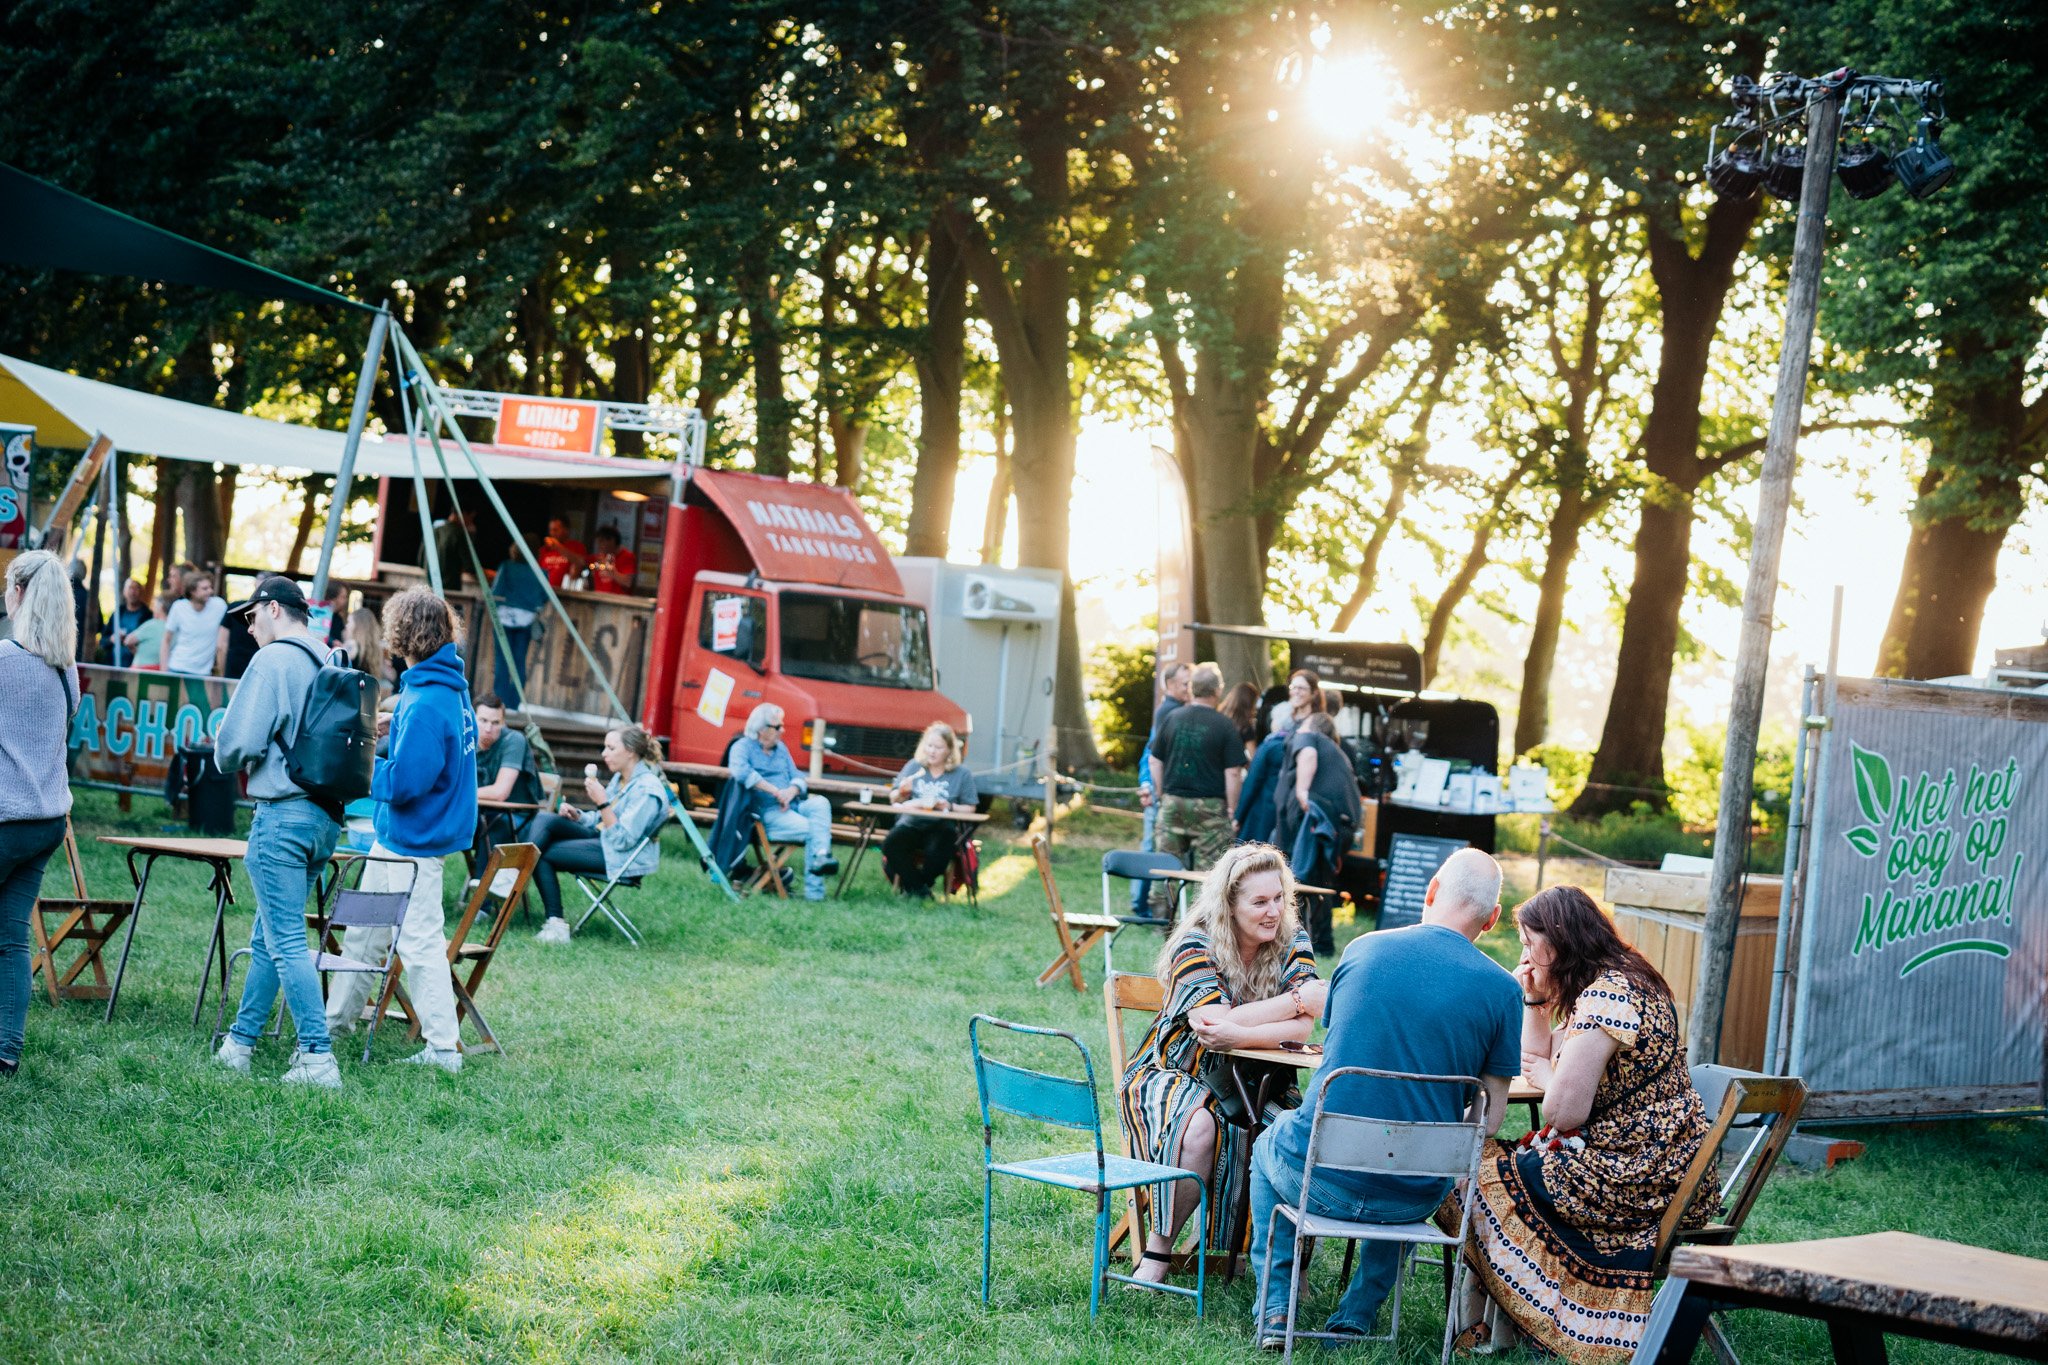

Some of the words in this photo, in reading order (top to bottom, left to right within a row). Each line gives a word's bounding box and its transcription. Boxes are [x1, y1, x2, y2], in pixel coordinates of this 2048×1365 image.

[516, 404, 580, 432] NATHALS
[746, 500, 863, 540] NATHALS
[766, 532, 877, 564] TANKWAGEN
[1889, 769, 1958, 836] Met
[1963, 757, 2021, 817] het
[1887, 827, 1959, 887] oog
[1966, 816, 2006, 876] op
[1852, 852, 2023, 955] Mañana!
